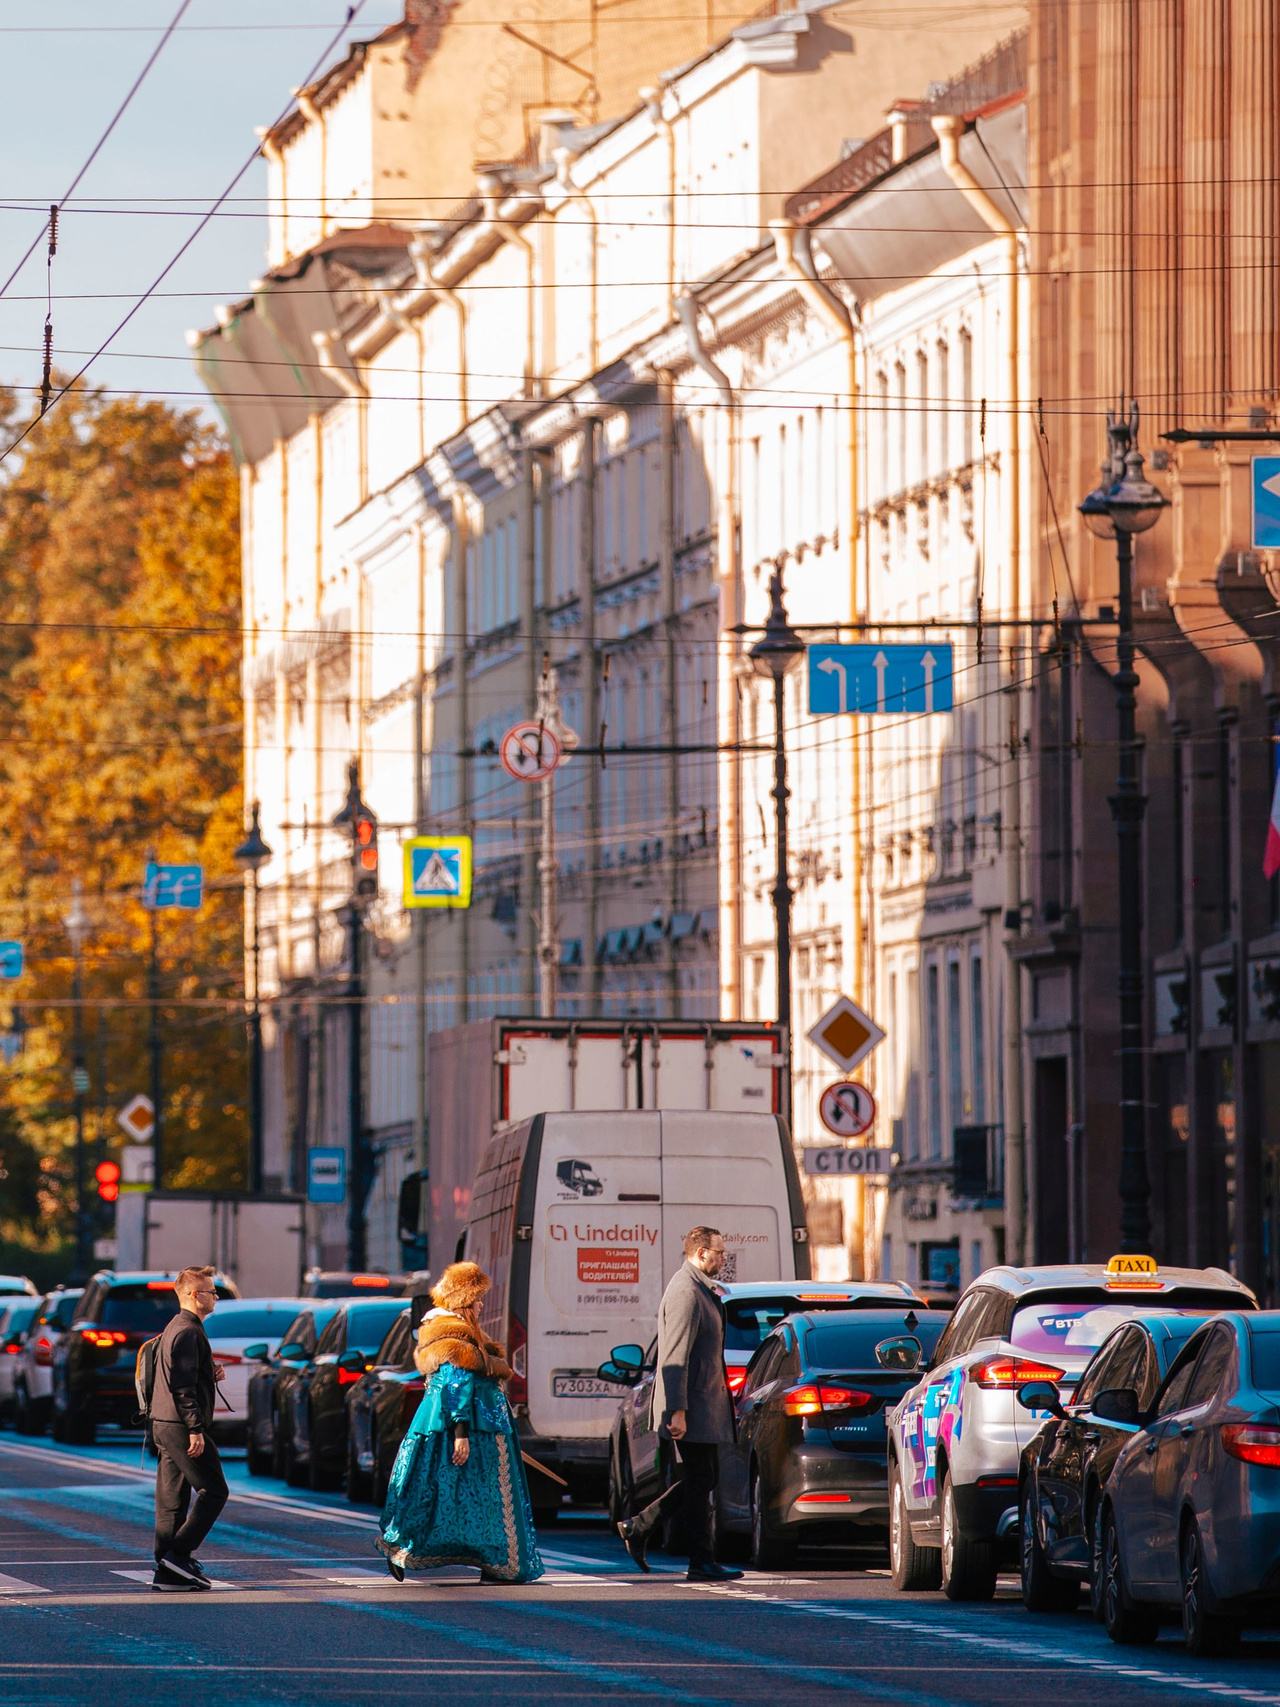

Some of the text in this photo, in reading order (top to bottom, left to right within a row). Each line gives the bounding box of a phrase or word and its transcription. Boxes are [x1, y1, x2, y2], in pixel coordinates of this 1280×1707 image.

[815, 1151, 881, 1171] СТОП
[574, 1224, 658, 1246] Lindaily
[680, 1232, 769, 1245] wdaily.com
[579, 1261, 638, 1270] ПРИГЛАШАЕМ
[1114, 1259, 1150, 1272] TAXI
[582, 1271, 635, 1281] ВОДИТЕЛЕЙ!
[577, 1294, 582, 1303] 8
[1055, 1318, 1083, 1329] ВТБ
